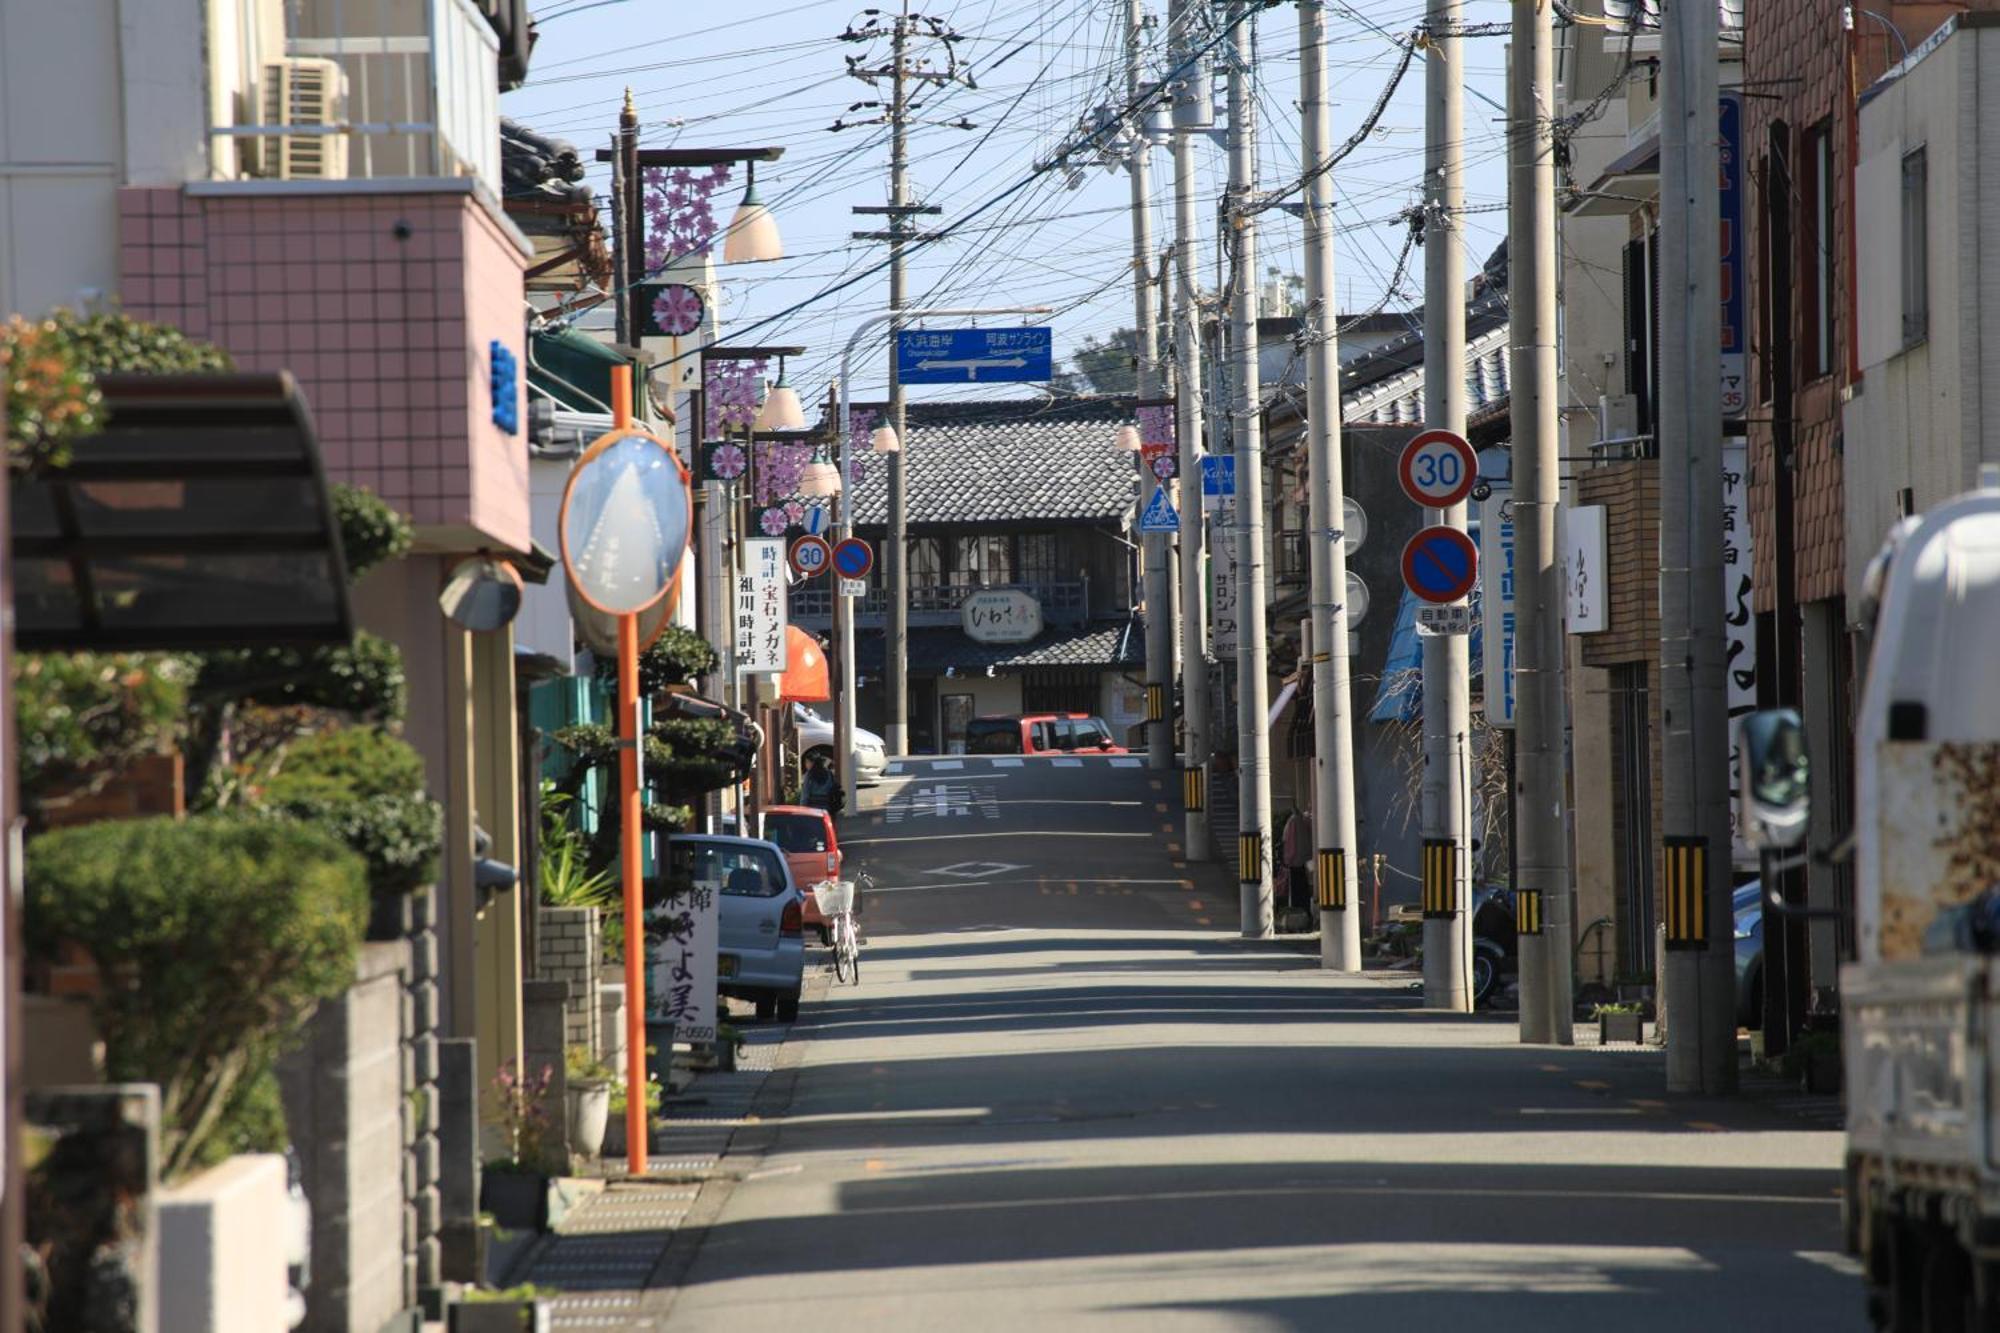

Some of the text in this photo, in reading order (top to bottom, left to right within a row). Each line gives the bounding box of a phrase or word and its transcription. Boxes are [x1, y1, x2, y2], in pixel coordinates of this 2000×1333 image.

[903, 334, 953, 348] 大浜海岸
[985, 332, 1046, 346] 阿波サンライン
[1417, 452, 1459, 488] 30
[799, 547, 823, 566] 30
[1421, 608, 1463, 621] 自動車
